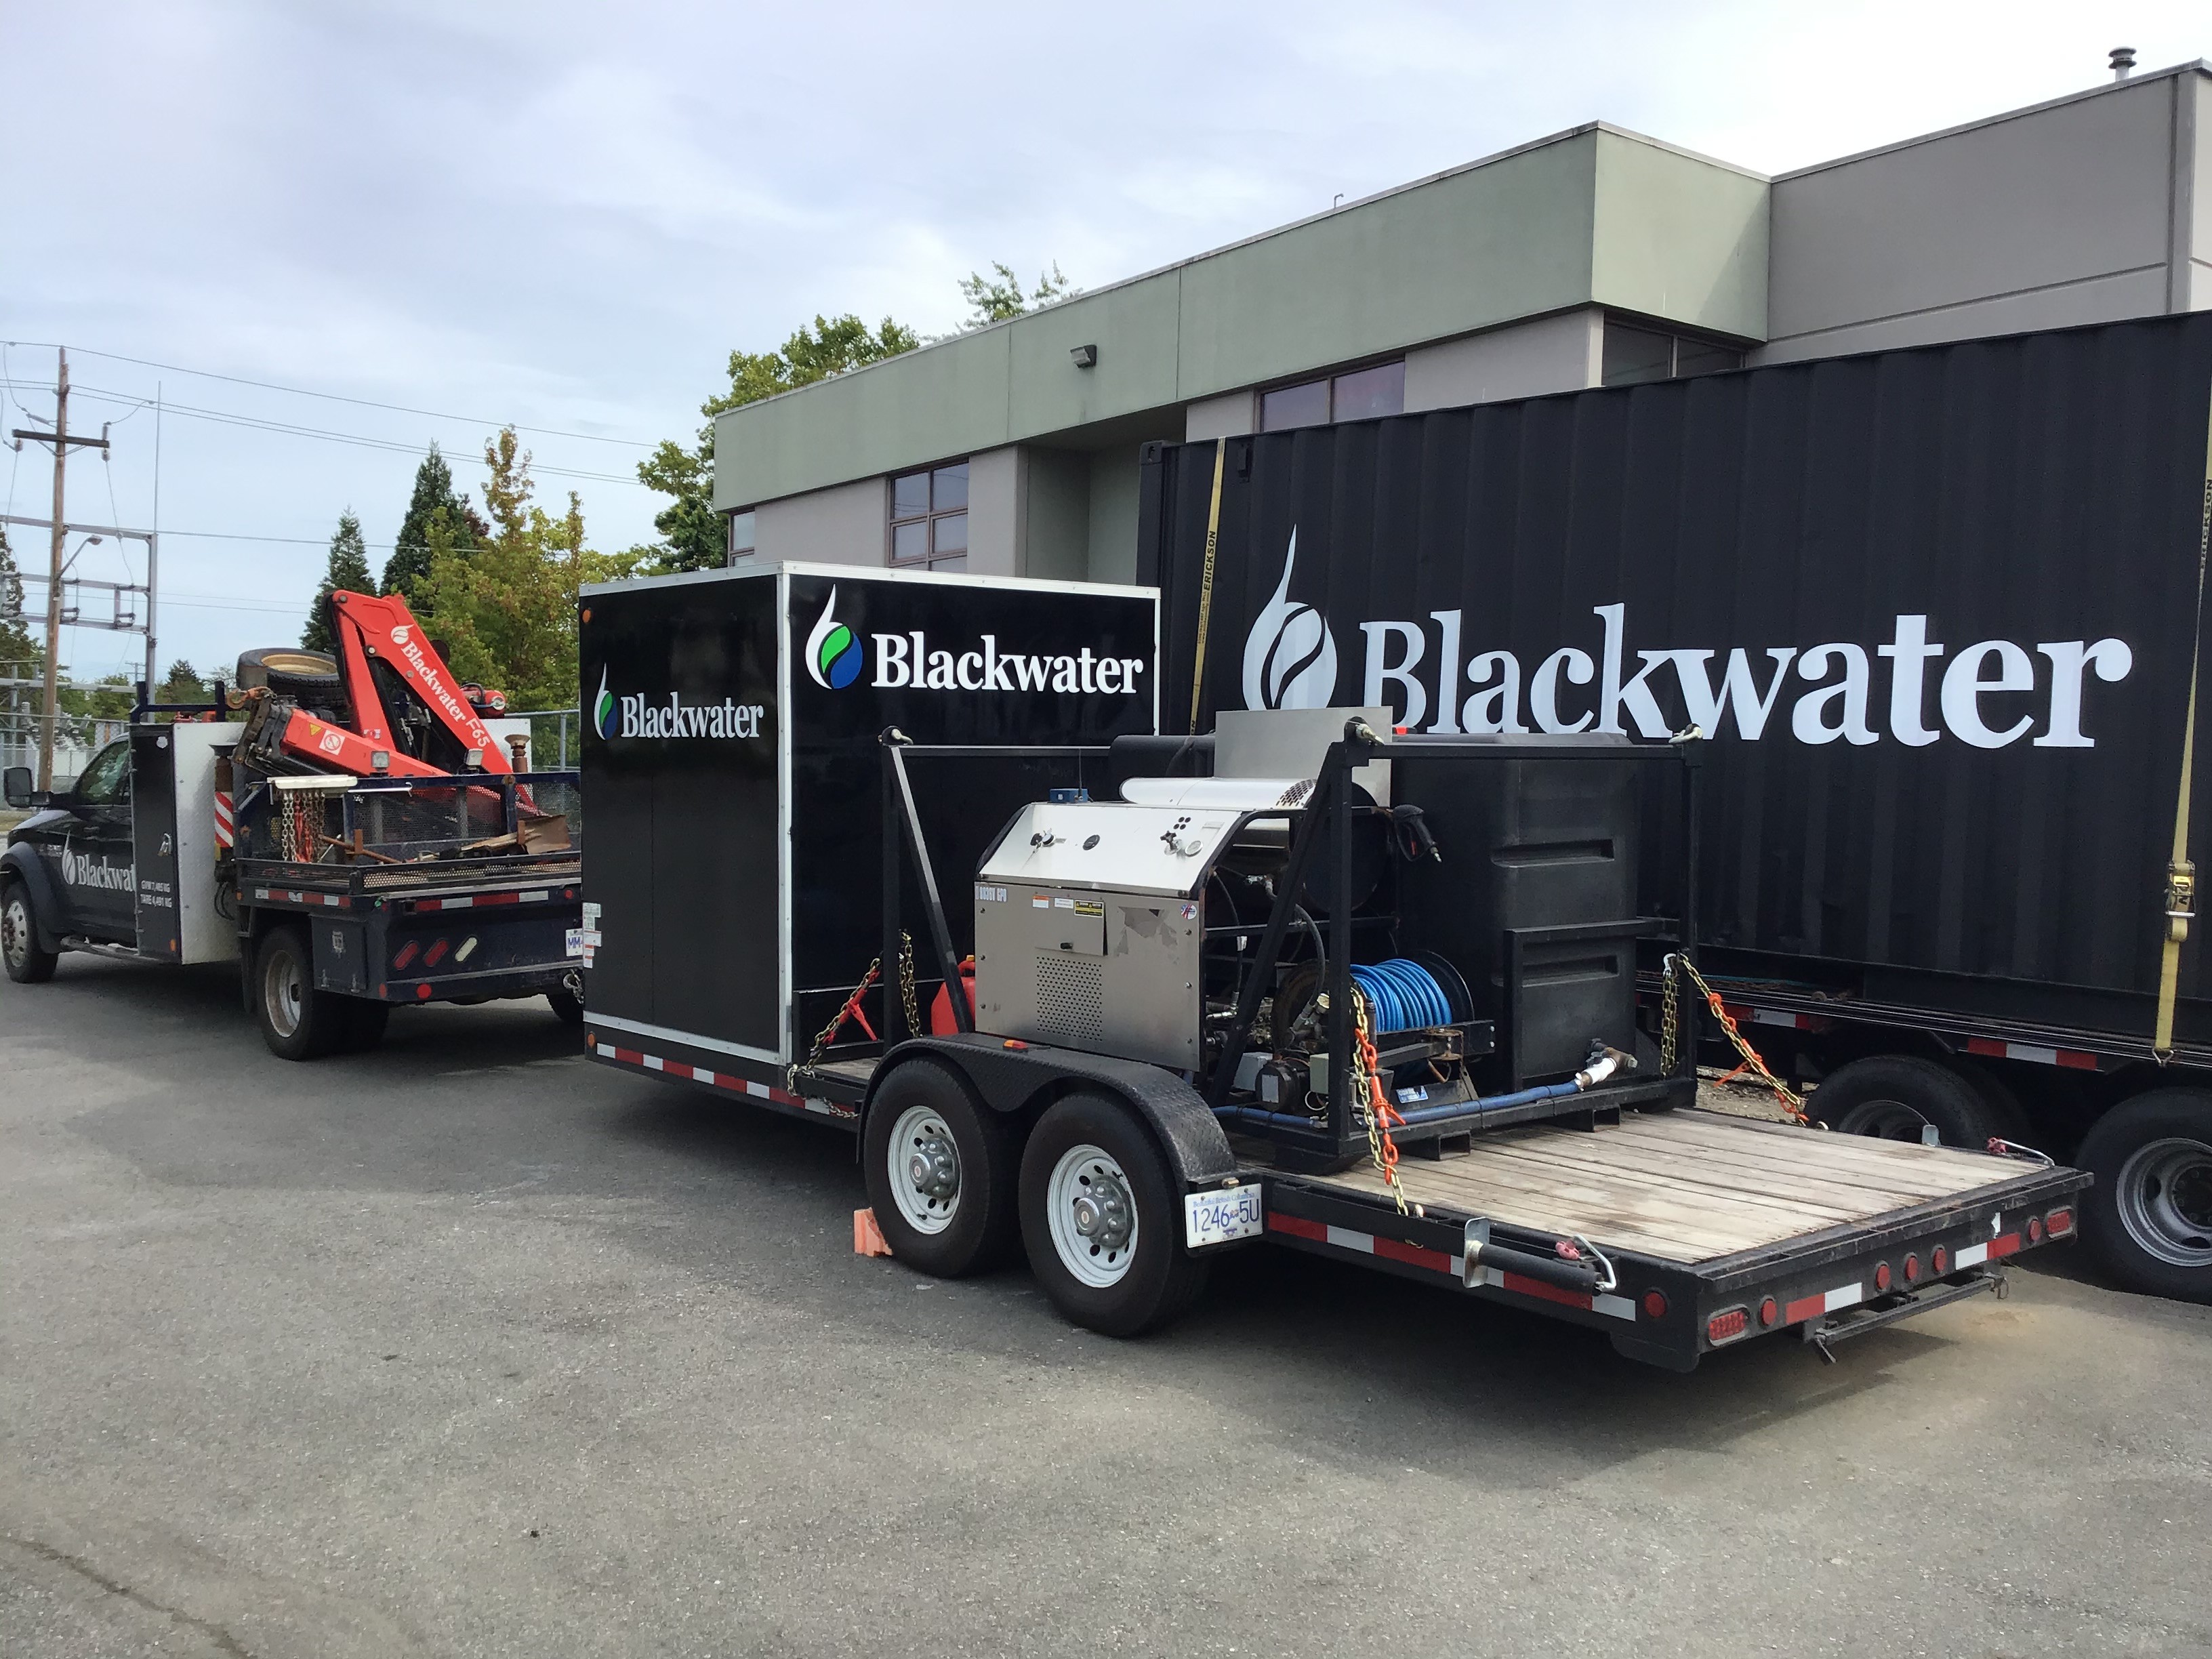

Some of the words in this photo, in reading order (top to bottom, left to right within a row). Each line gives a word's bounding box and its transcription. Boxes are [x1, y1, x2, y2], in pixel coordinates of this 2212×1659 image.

[1203, 531, 1216, 591] ERICKSON
[871, 631, 1144, 694] Blackwater
[1359, 602, 2132, 749] Blackwater
[401, 641, 466, 722] Blackwater
[466, 718, 491, 747] F65
[620, 691, 764, 739] Blackwater
[1193, 1204, 1230, 1233] 1246
[1240, 1198, 1259, 1224] 5U
